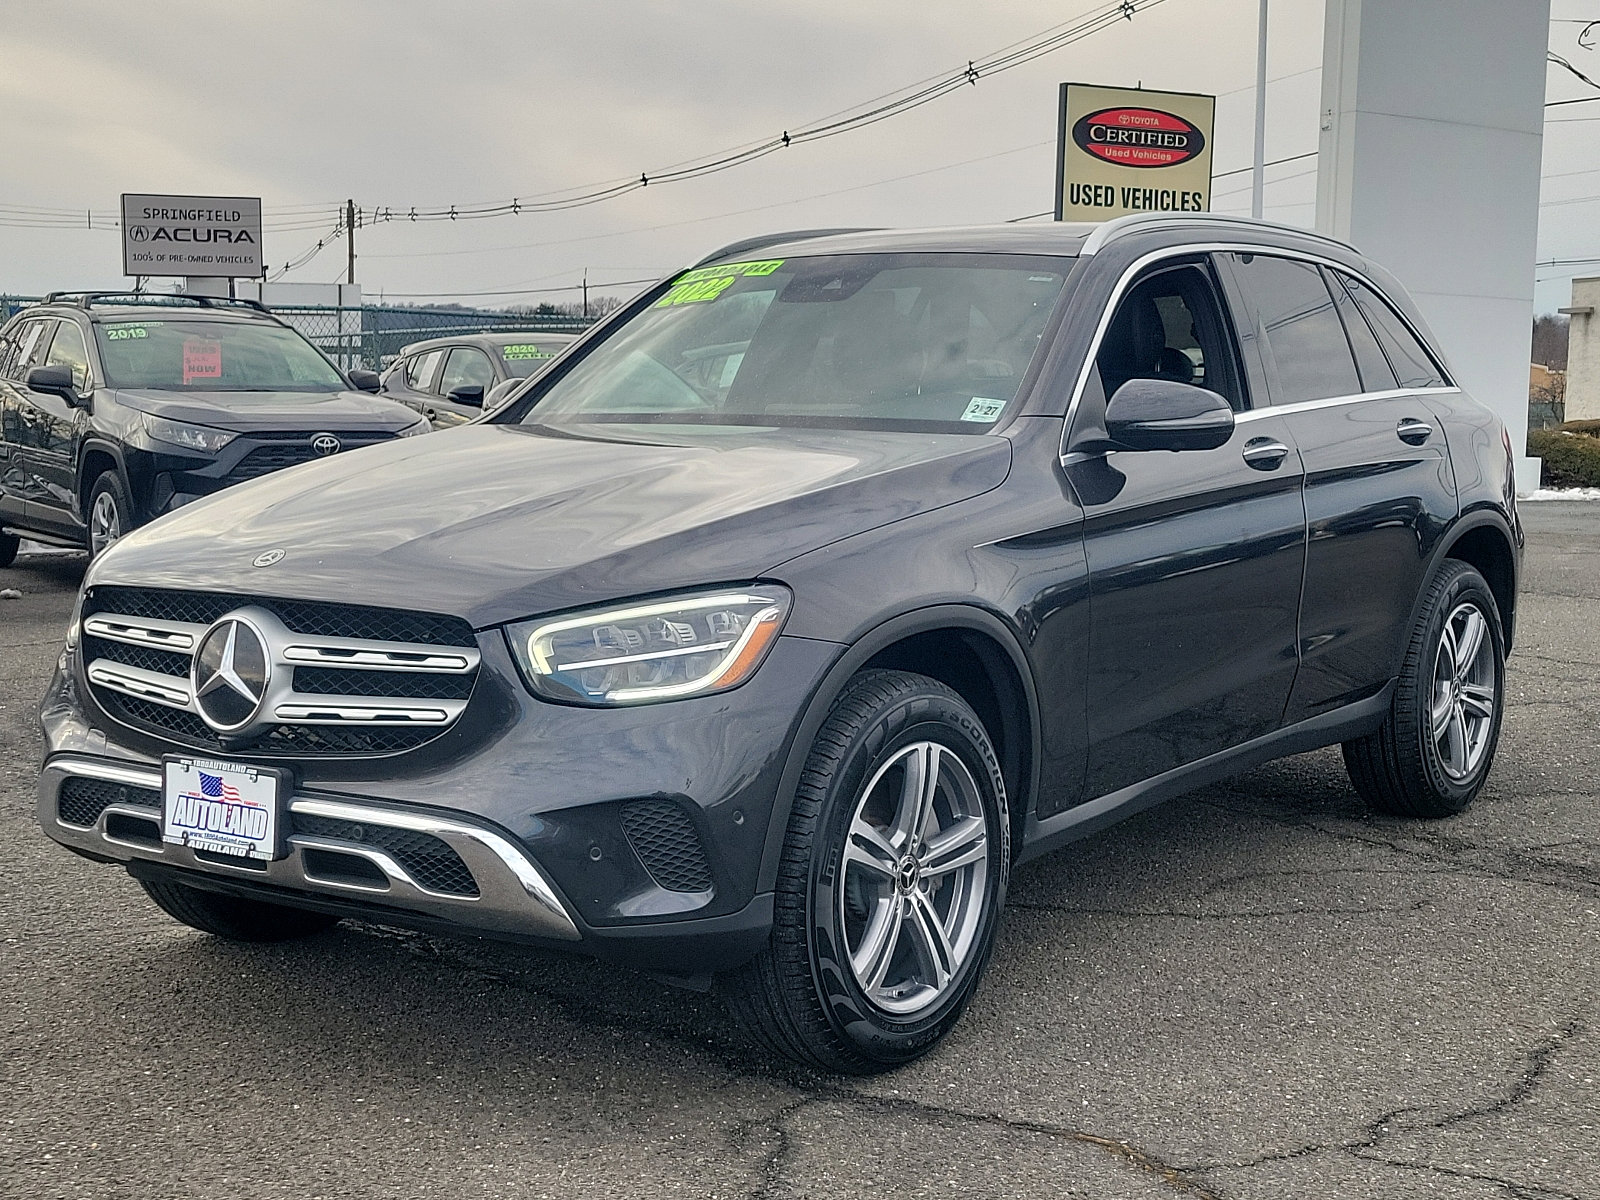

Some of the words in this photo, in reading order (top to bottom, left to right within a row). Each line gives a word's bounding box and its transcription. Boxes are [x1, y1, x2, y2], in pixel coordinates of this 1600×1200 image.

[1130, 116, 1160, 126] TOYOTA
[1090, 125, 1188, 148] CERTIFIED
[1105, 148, 1130, 158] Used
[1132, 149, 1172, 161] Vehicles
[1070, 183, 1115, 208] USED
[1121, 187, 1203, 212] VEHICLES
[143, 207, 241, 222] SPRINGFIELD
[151, 227, 255, 244] ACURA
[156, 254, 166, 262] OF
[169, 254, 214, 263] PRE-OWNED
[215, 255, 254, 264] VEHICLES
[654, 276, 735, 308] 2022
[108, 328, 148, 340] 2019
[503, 344, 539, 354] 2020
[970, 404, 980, 414] 2
[983, 406, 999, 415] 27
[949, 710, 1008, 815] SCORPION
[172, 795, 268, 841] AUTOLAND
[187, 839, 247, 857] AUTOLAND
